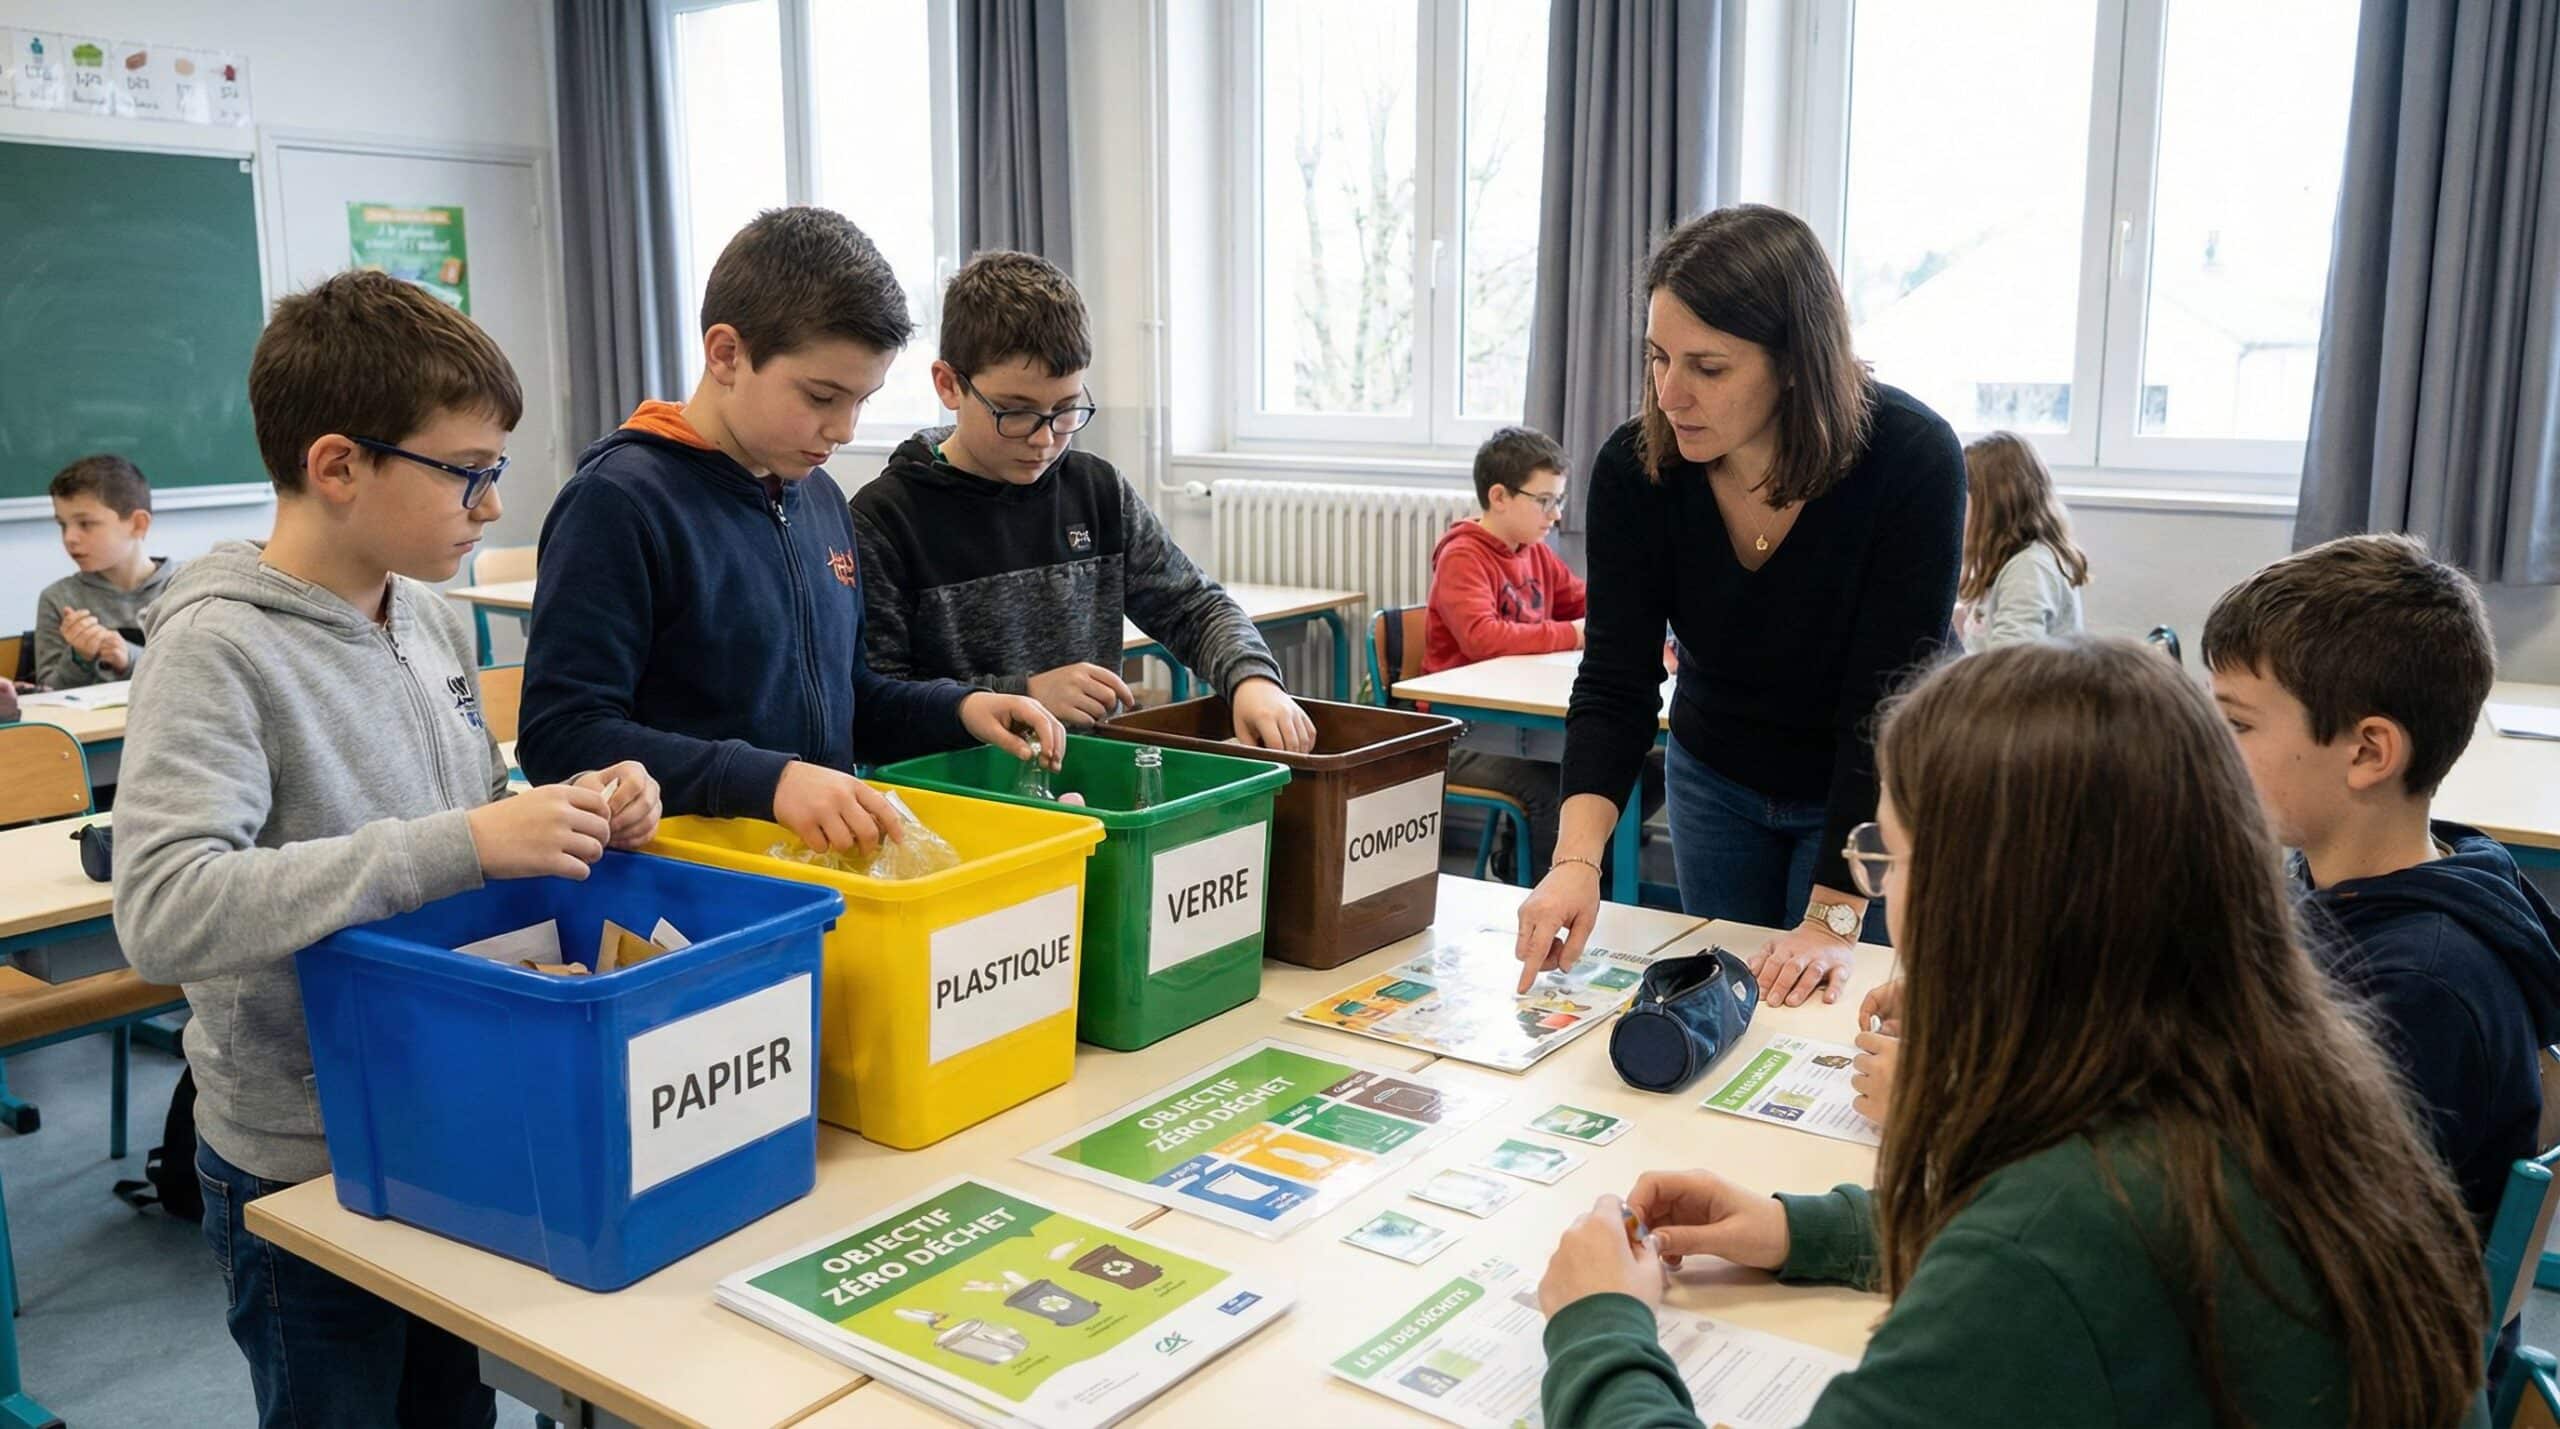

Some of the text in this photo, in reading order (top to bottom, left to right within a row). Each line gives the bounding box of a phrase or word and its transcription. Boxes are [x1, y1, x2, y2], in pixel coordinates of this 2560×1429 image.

[1347, 811, 1440, 862] COMPOST
[1168, 868, 1249, 924] VERRE
[937, 934, 1071, 1009] PLASTIQUE
[652, 1037, 792, 1129] PAPIER
[1138, 1077, 1240, 1130] OBJECTIF
[1145, 1117, 1216, 1152] ZÉRO
[1206, 1075, 1296, 1121] DÉCHET
[821, 1206, 1017, 1306] ZÉRO DÉCHET
[822, 1208, 952, 1273] OBJECTIF
[1353, 1354, 1375, 1369] LE
[1391, 1324, 1421, 1344] DES
[1415, 1287, 1471, 1328] DÉCHETS
